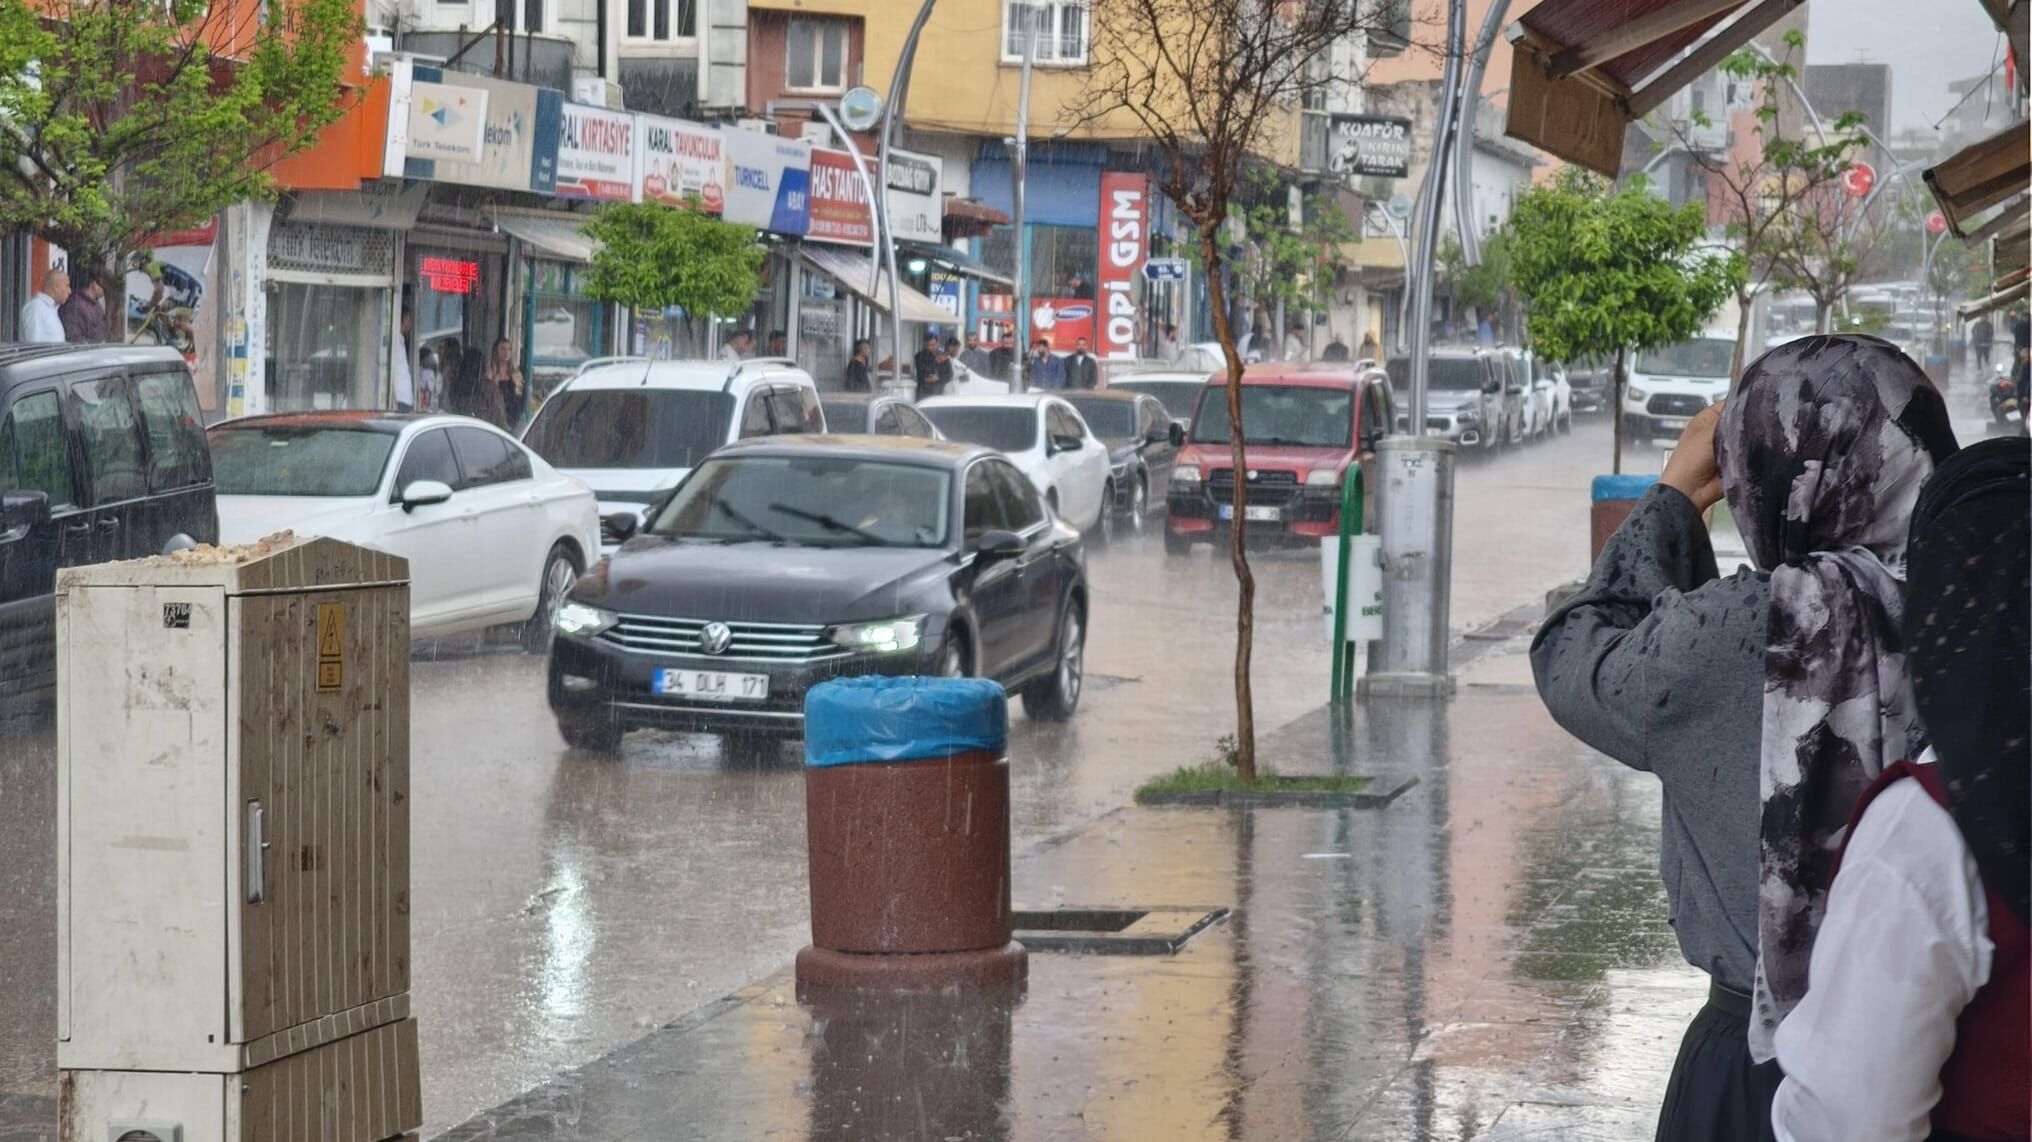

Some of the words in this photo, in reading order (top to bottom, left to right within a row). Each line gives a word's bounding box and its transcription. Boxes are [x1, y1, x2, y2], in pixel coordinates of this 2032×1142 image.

[484, 120, 512, 146] lekom
[560, 113, 579, 149] RAL
[581, 115, 631, 157] KIRTASİYE
[647, 126, 673, 153] KARAL
[1340, 121, 1405, 140] KUAFÖR
[812, 164, 833, 199] HAS
[1111, 190, 1141, 267] GSM
[1104, 281, 1137, 360] LOPİ
[664, 671, 682, 690] 34
